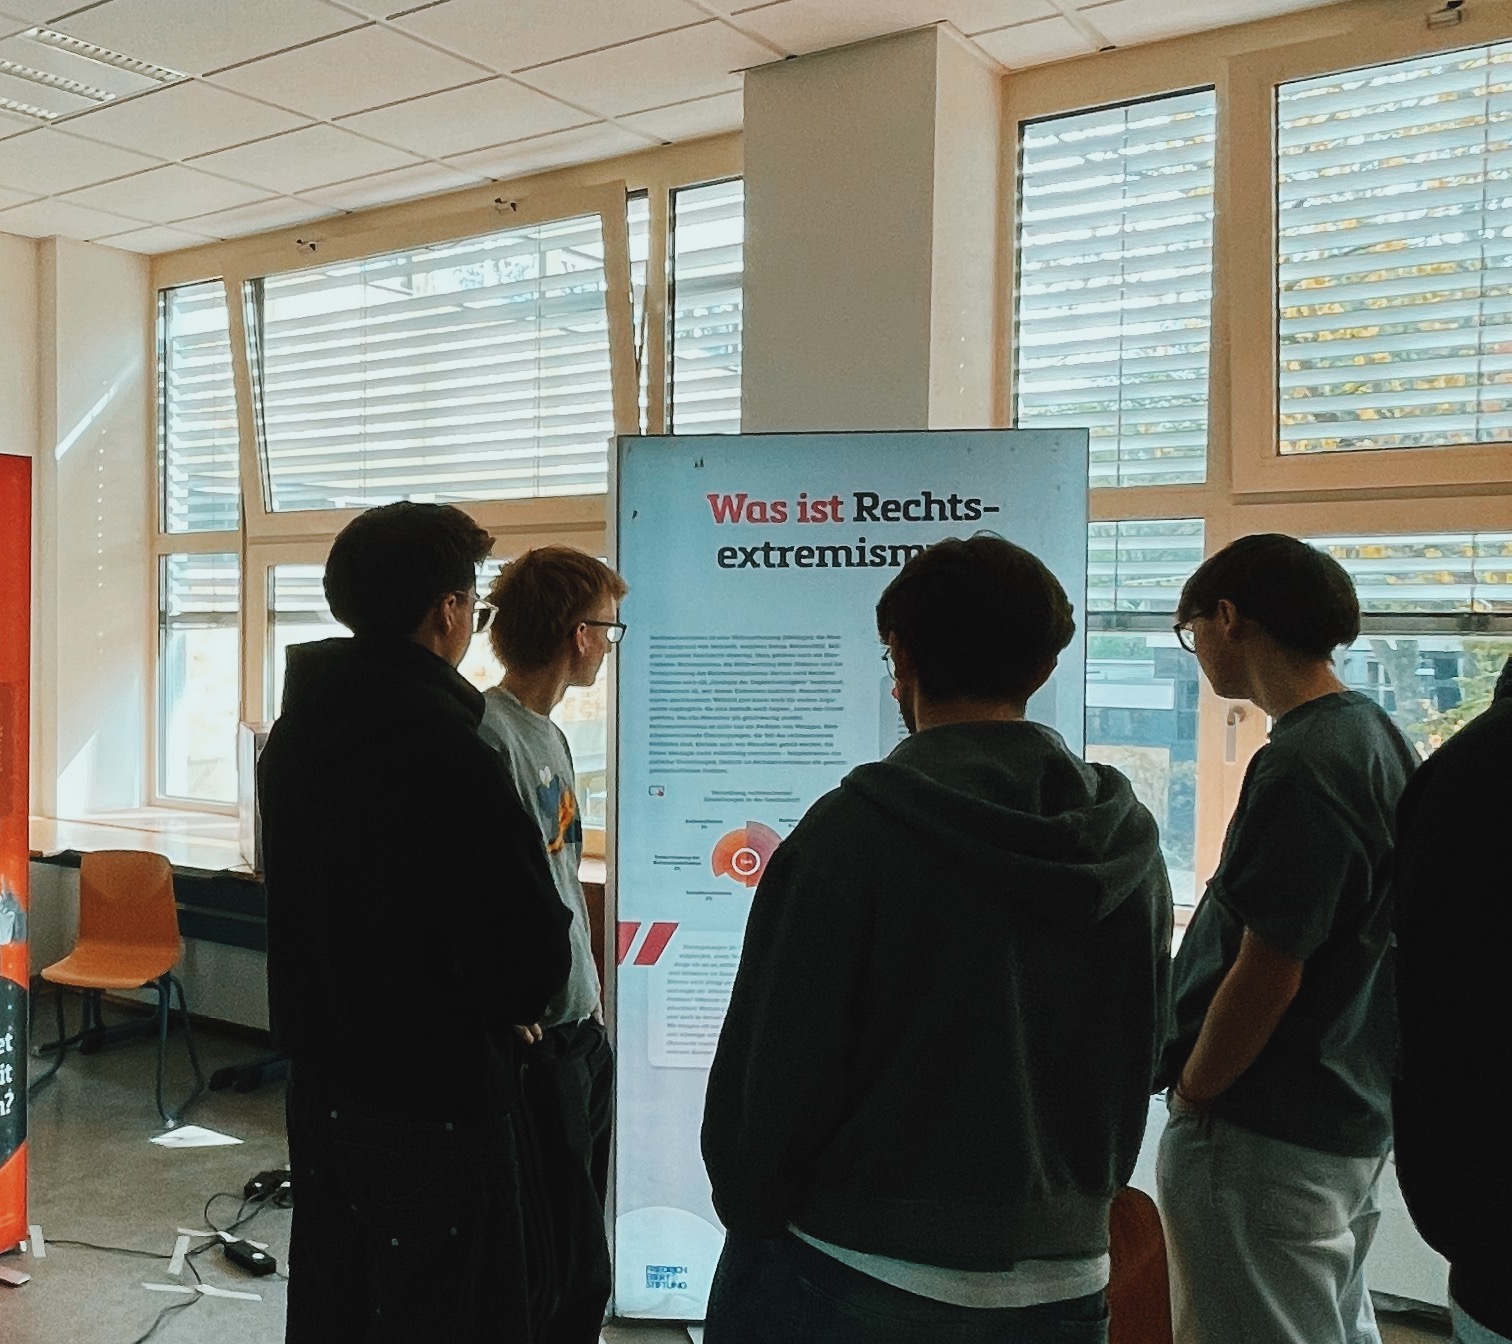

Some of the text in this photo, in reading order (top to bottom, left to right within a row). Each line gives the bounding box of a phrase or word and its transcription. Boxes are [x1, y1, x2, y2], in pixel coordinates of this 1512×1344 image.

[707, 490, 1001, 524] Was ist Rechts-
